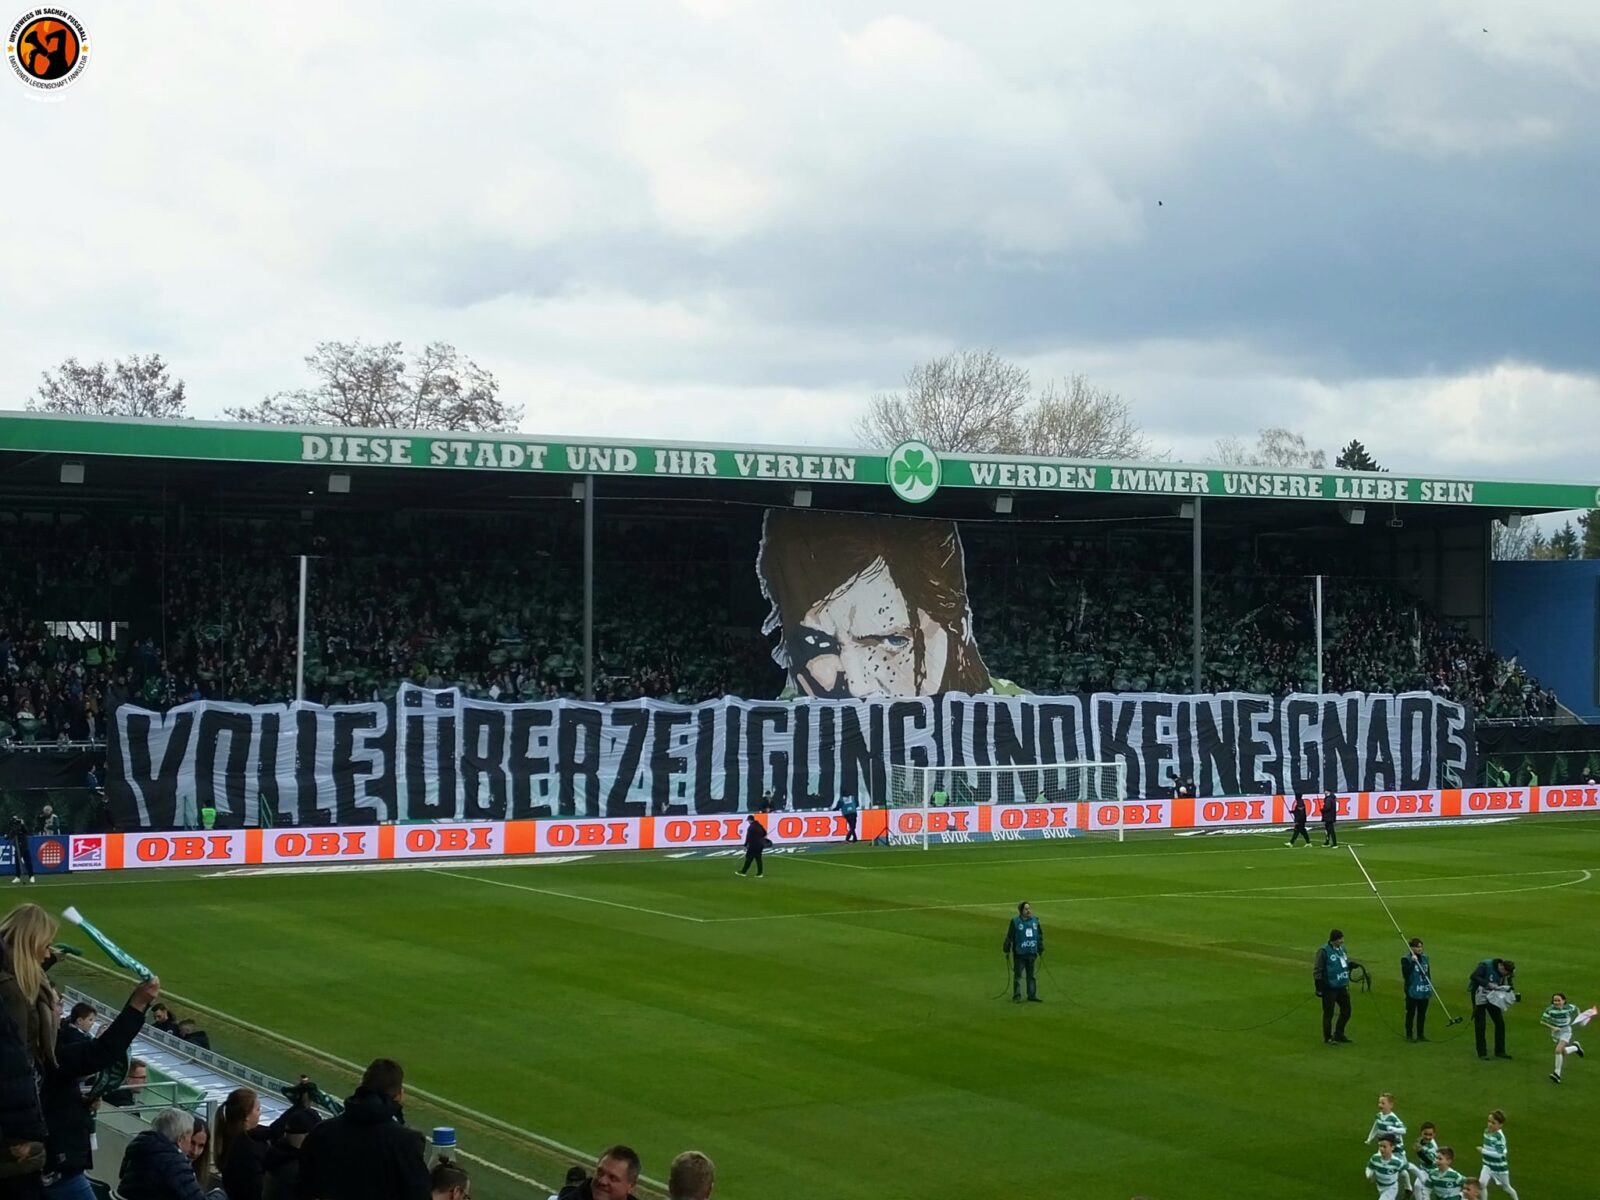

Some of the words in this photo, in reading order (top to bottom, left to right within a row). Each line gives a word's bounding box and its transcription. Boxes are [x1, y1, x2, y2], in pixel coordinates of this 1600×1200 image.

[301, 435, 412, 464] DIESE
[430, 441, 548, 469] STADT
[566, 446, 638, 472] UND
[654, 450, 717, 475] IHR
[734, 453, 856, 480] VEREIN
[969, 463, 1096, 489] WERDEN
[1110, 468, 1210, 493] IMMER
[1222, 473, 1324, 498] UNSERE
[1335, 478, 1409, 500] LIEBE
[1420, 481, 1474, 503] SEIN
[120, 706, 384, 826] VOLLE
[402, 688, 930, 818] ÜBERZEUGUNG
[946, 697, 1084, 803] UND
[1096, 698, 1276, 800] KEINE
[1285, 696, 1472, 794] GNADE
[1376, 794, 1434, 815] OBI
[1468, 790, 1524, 811] OBI
[1546, 788, 1598, 808] OBI
[1000, 807, 1068, 830] OBI
[1097, 804, 1163, 826] OBI
[1202, 799, 1266, 822] OBI
[664, 818, 744, 843] OBI
[898, 811, 970, 834] OBI
[1042, 827, 1076, 840] BVUK.
[274, 831, 367, 857] OBI
[405, 826, 493, 852] OBI
[546, 822, 630, 848] OBI
[940, 831, 975, 844] BVUK.
[992, 829, 1026, 842] BVUK.
[91, 849, 100, 860] 2
[136, 835, 233, 862] OBI
